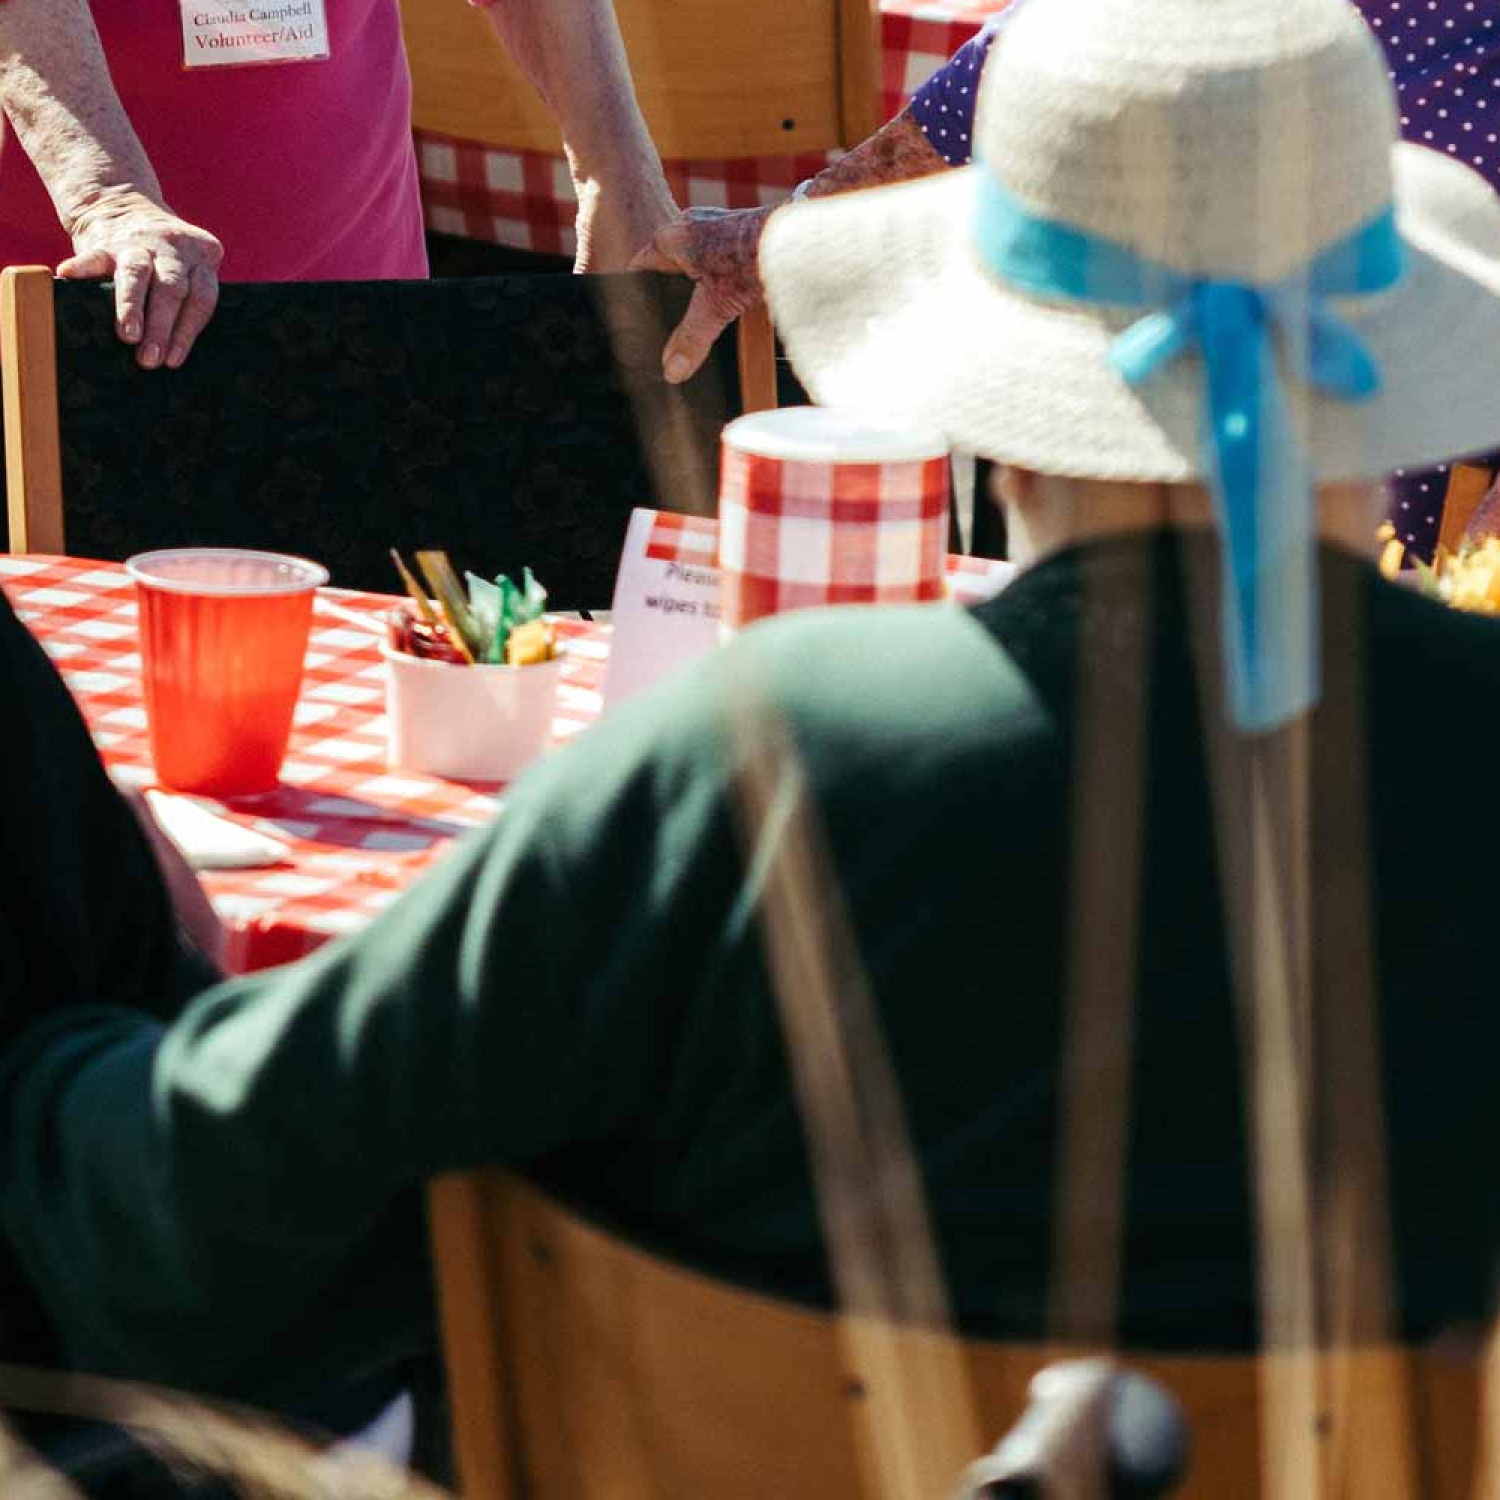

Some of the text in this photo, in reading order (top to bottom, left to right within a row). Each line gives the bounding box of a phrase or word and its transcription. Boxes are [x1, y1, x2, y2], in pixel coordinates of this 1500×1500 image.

[194, 1, 312, 27] Claudia Campbell
[195, 23, 313, 49] Volunteer/Aid
[645, 596, 697, 614] wipes
